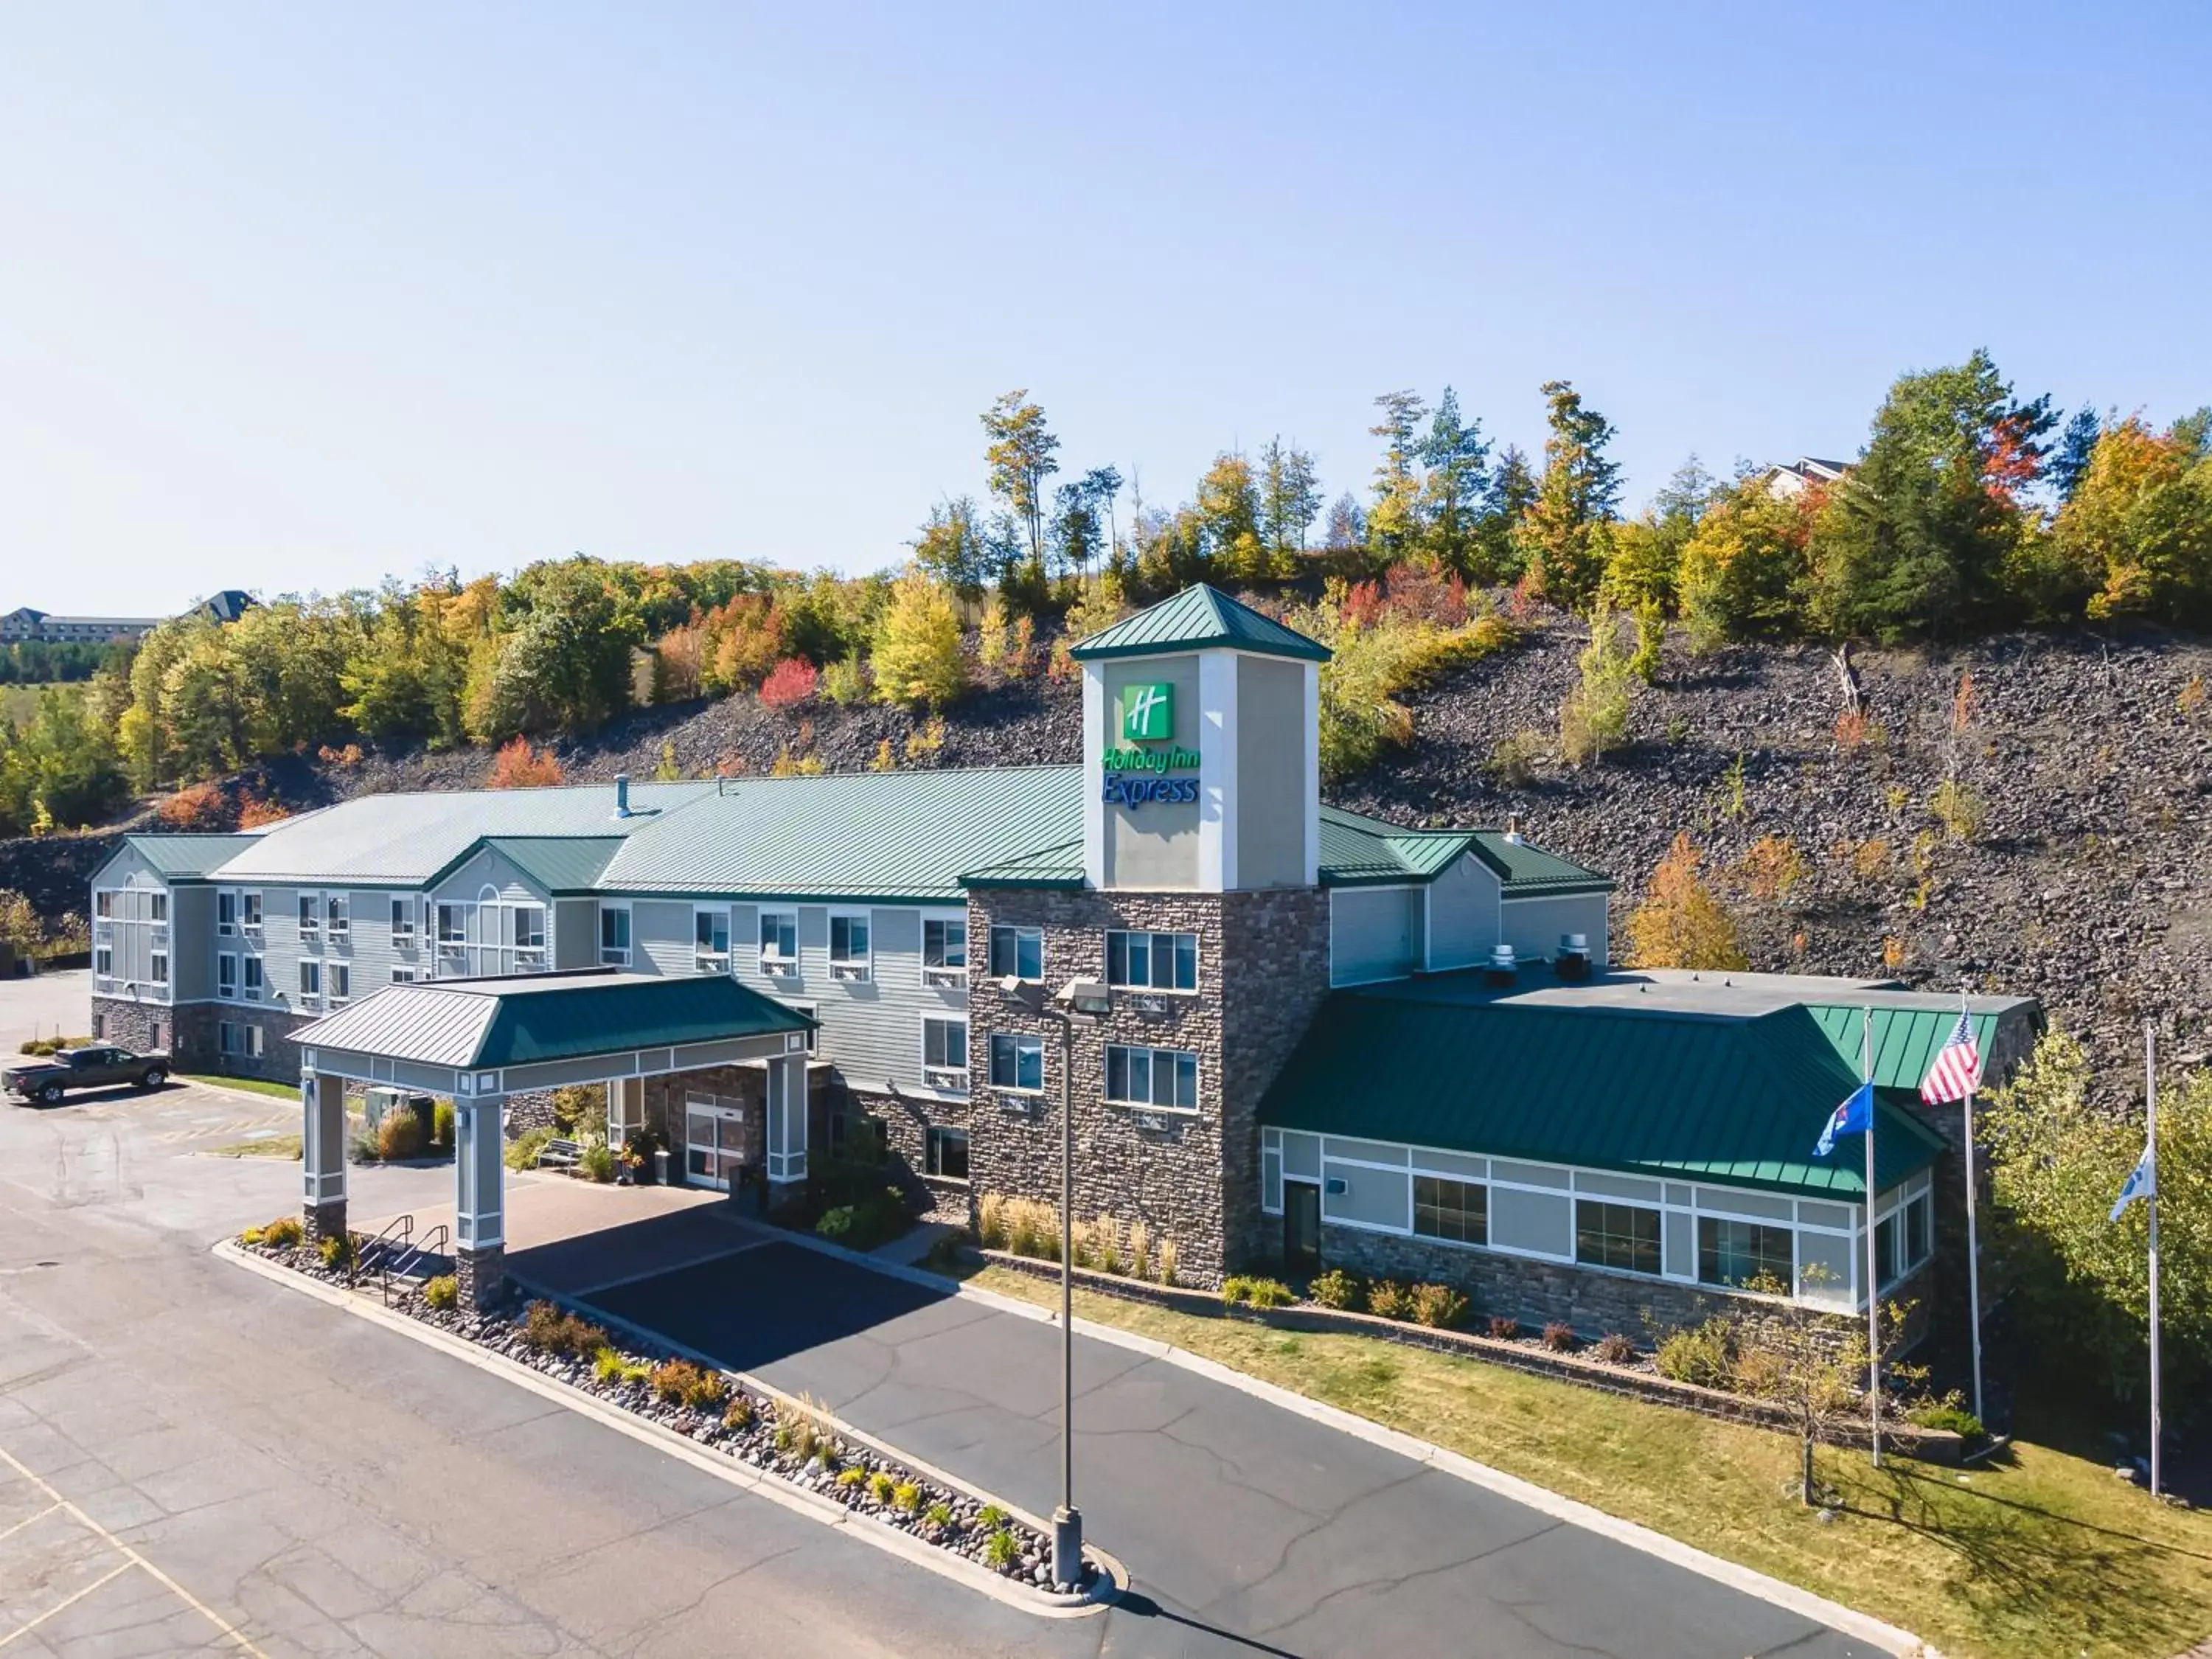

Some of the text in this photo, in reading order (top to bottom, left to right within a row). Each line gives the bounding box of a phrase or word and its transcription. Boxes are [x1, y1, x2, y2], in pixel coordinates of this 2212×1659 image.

[1103, 745, 1200, 773] Holiday Inn
[1103, 775, 1200, 810] Express
